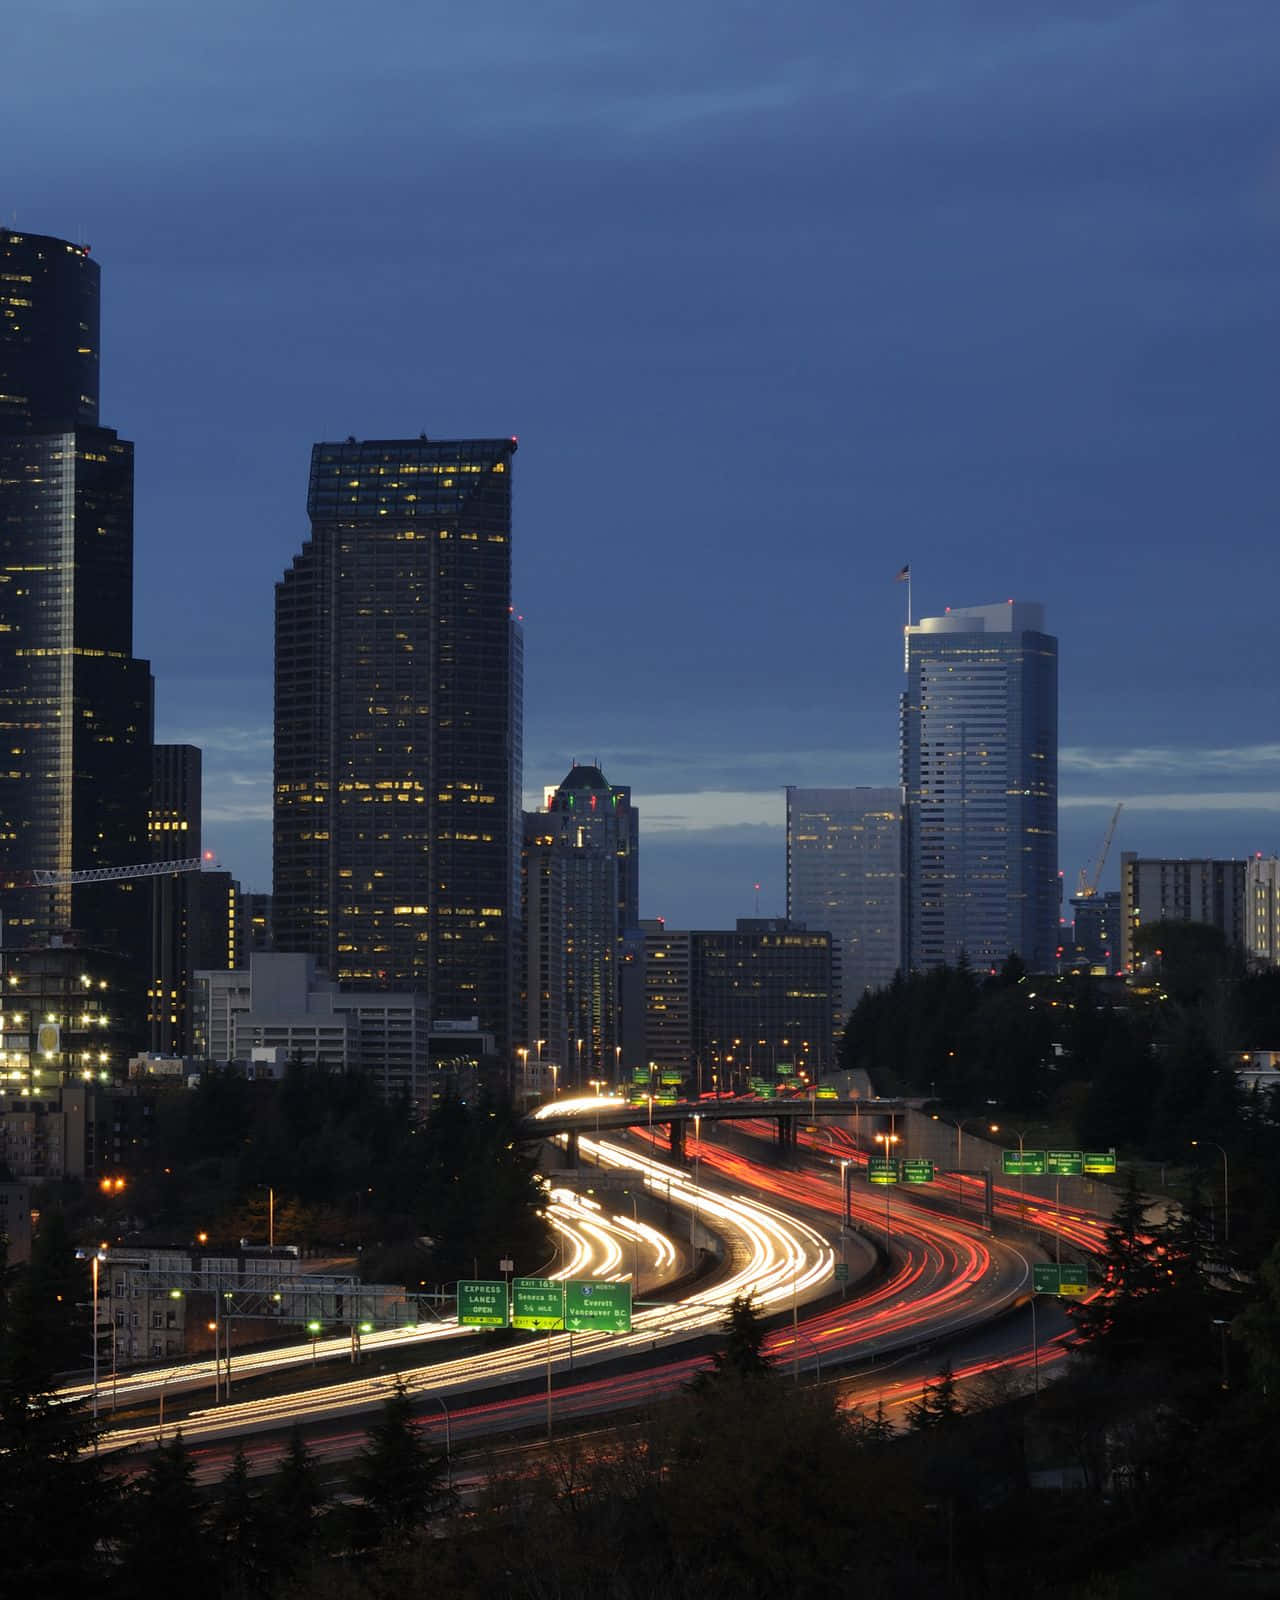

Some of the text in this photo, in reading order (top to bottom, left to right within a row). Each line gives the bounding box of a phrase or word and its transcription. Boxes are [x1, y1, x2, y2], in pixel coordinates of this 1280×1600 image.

[464, 1285, 501, 1294] EXPRESS
[469, 1296, 496, 1304] LANES
[517, 1292, 545, 1301] Seneca
[583, 1299, 613, 1307] Everett
[473, 1306, 493, 1314] OPEN
[537, 1304, 553, 1312] MILE
[569, 1307, 611, 1317] Vancouver
